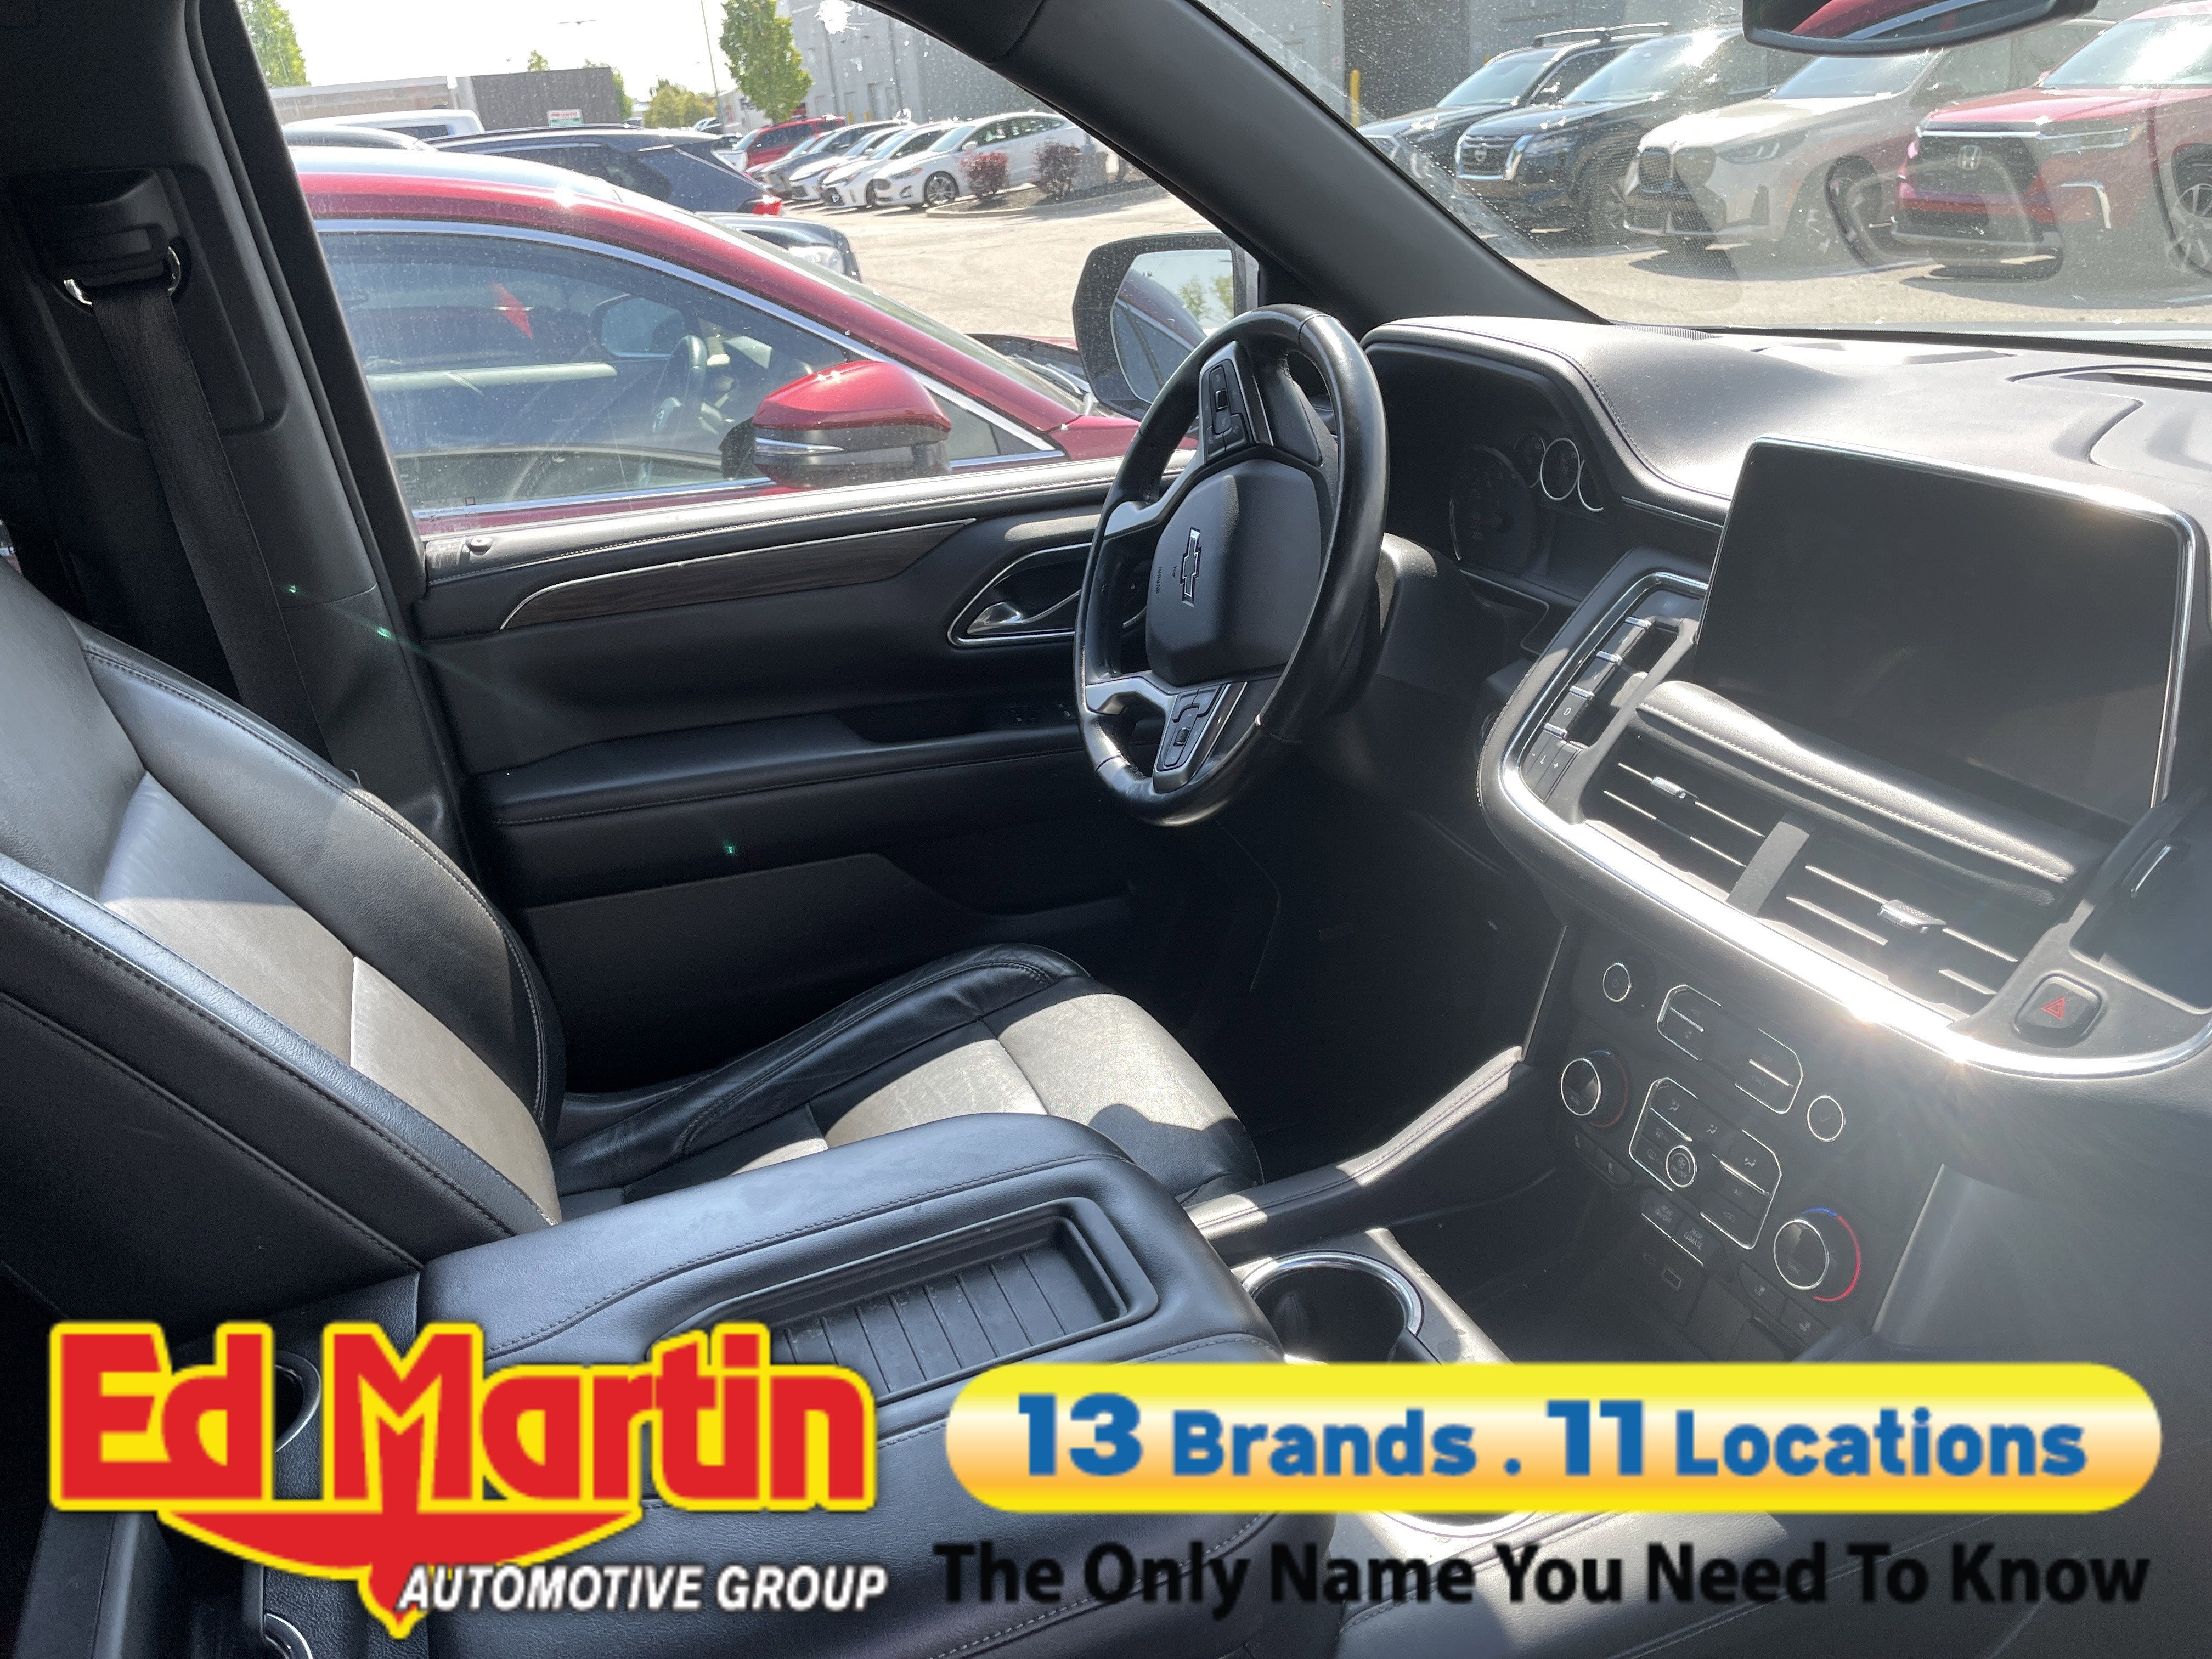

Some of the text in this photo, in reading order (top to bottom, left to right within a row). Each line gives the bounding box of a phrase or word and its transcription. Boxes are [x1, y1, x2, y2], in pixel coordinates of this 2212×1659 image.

[1541, 755, 1546, 764] L
[1655, 1208, 1672, 1223] ON/OFF
[1660, 1204, 1673, 1217] REAR
[1690, 1228, 1703, 1239] REAR
[1683, 1231, 1704, 1250] CLIMATE
